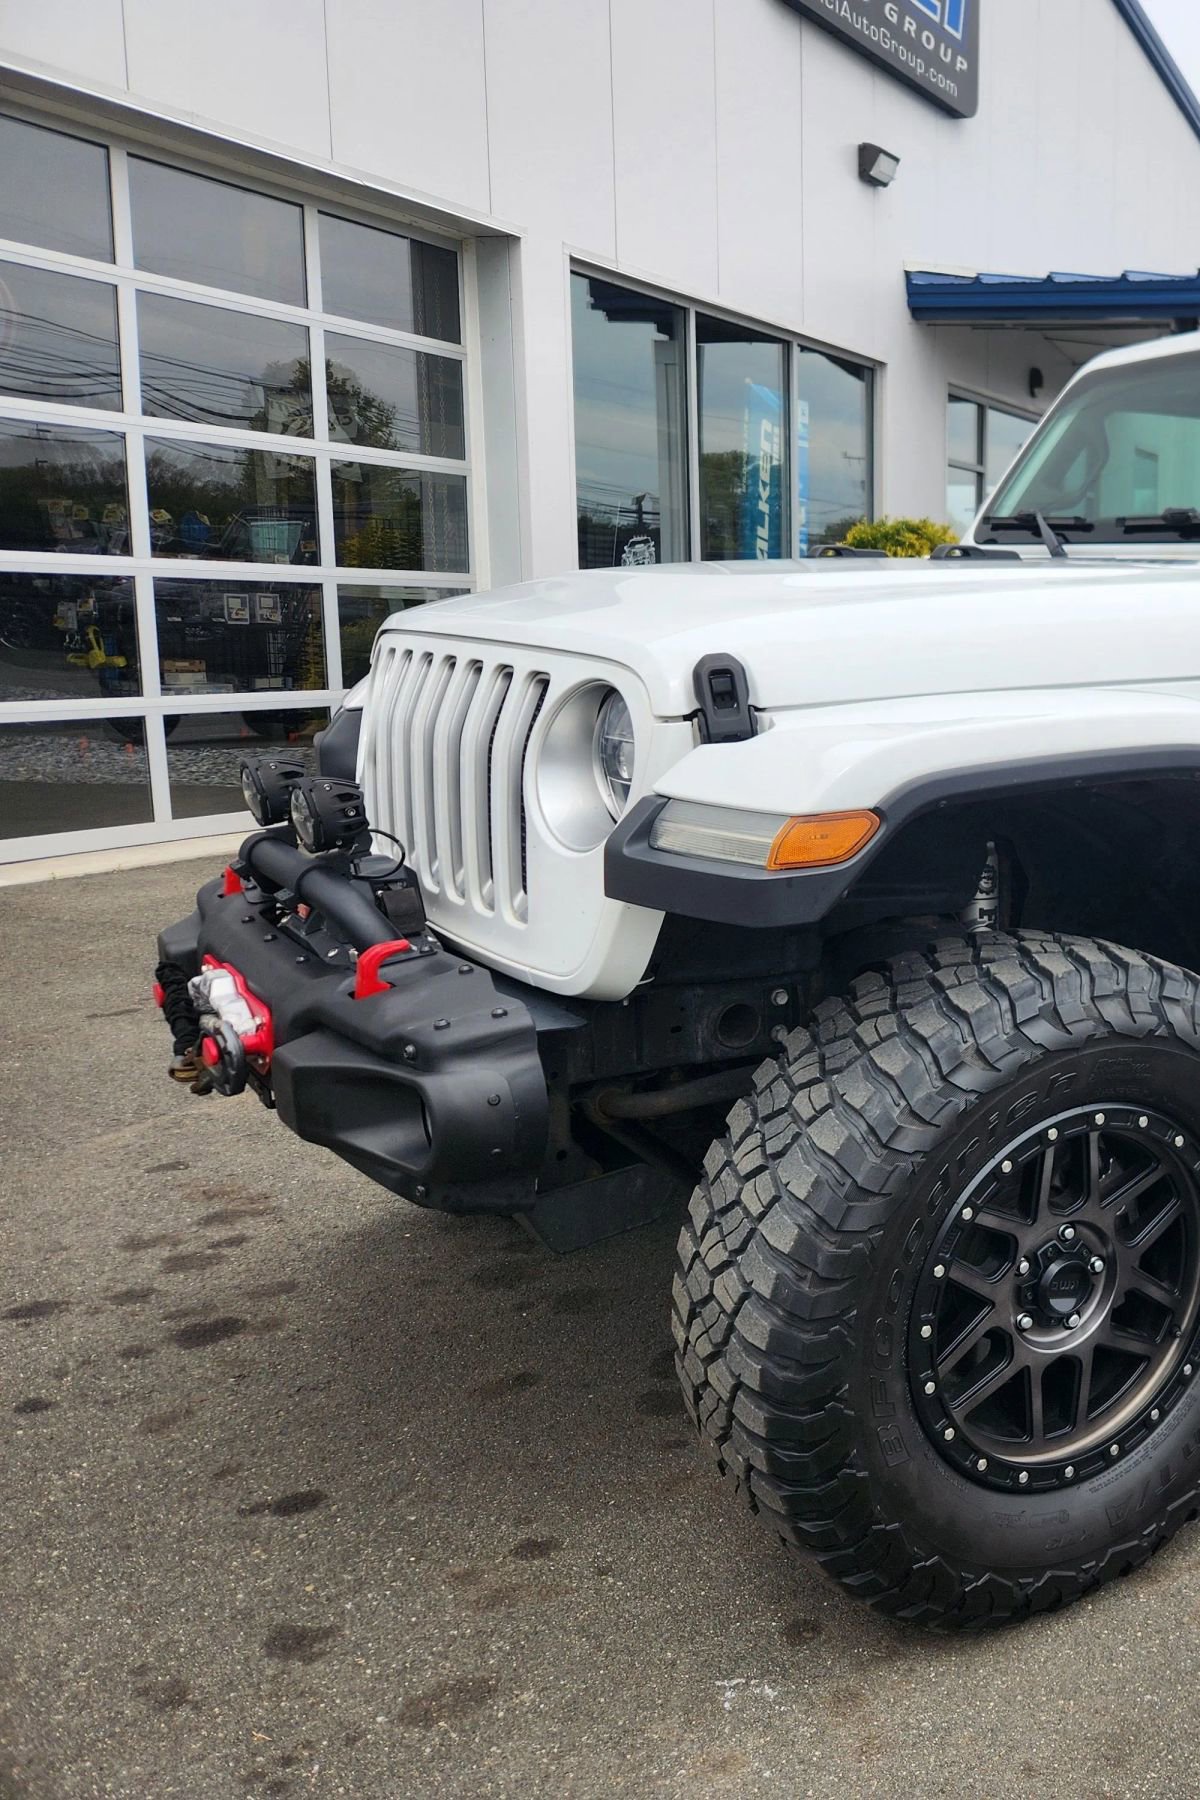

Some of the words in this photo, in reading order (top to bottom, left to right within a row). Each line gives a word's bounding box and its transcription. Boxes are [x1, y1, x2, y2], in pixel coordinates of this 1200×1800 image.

[818, 0, 958, 98] ciAutoGroup.com
[884, 2, 968, 72] GROUP
[756, 419, 772, 559] ALKEN
